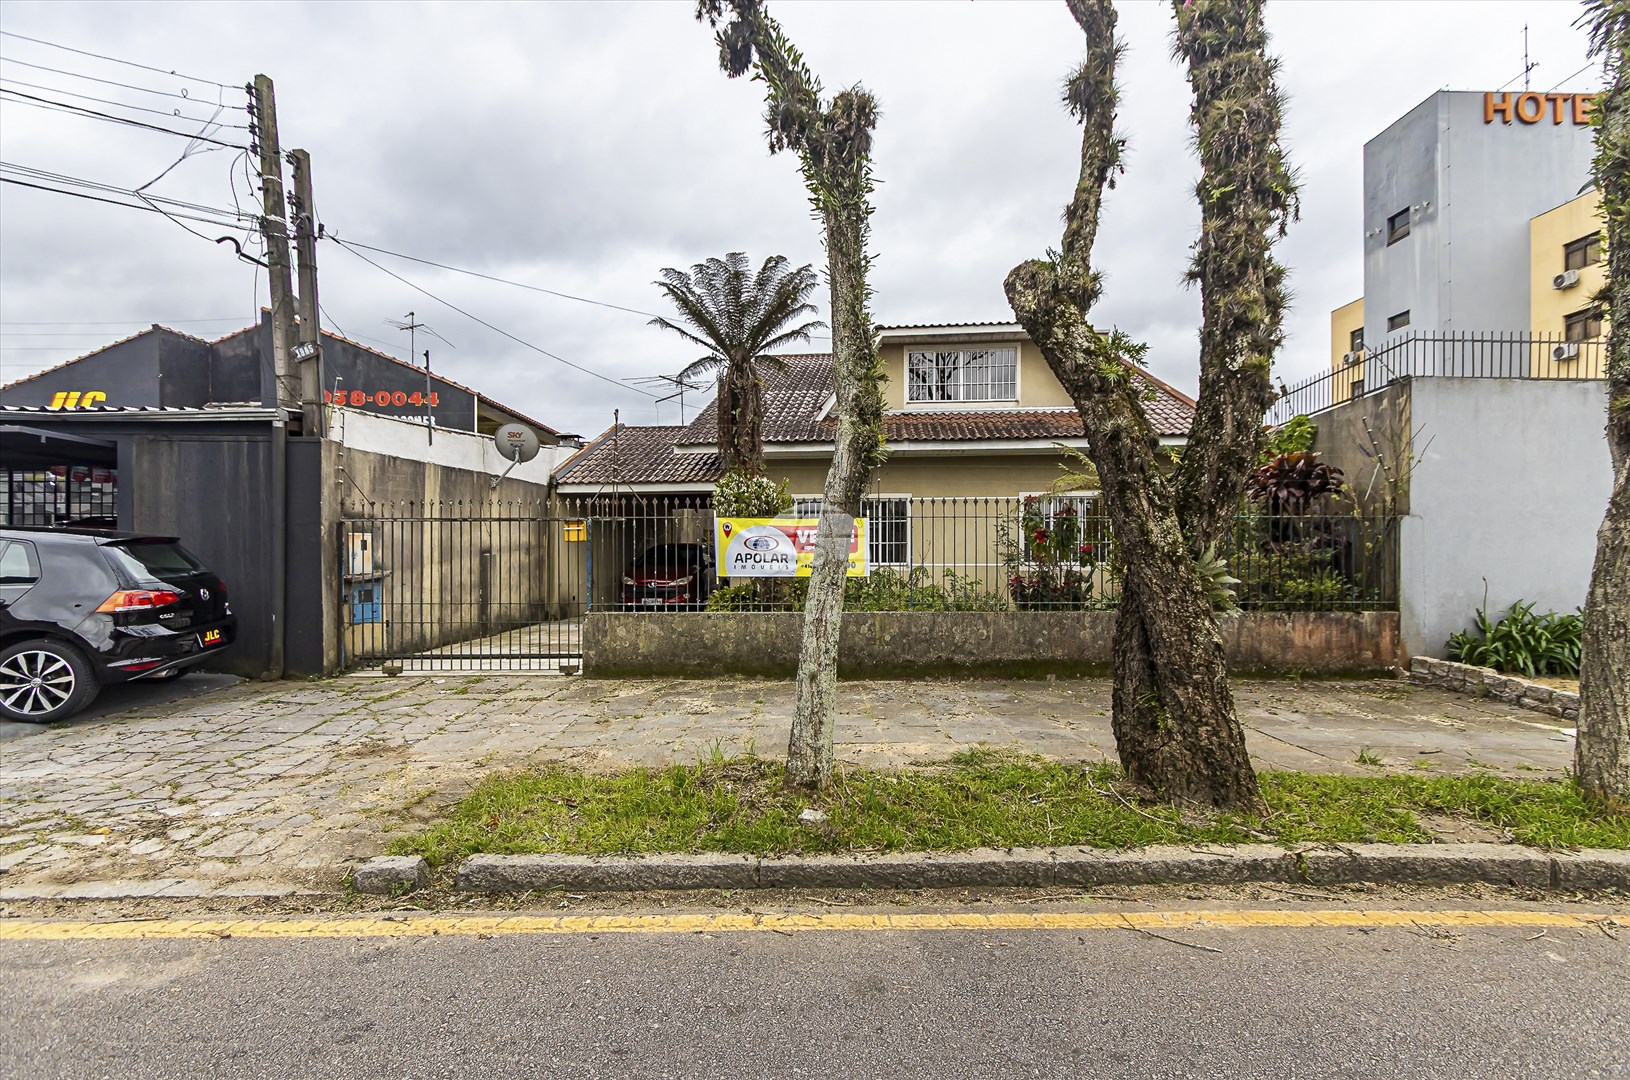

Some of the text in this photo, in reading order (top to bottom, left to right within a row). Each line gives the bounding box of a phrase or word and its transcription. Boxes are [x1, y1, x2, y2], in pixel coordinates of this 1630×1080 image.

[1484, 91, 1599, 125] HOTE
[734, 552, 789, 564] APOLAR
[204, 629, 220, 641] JLC
